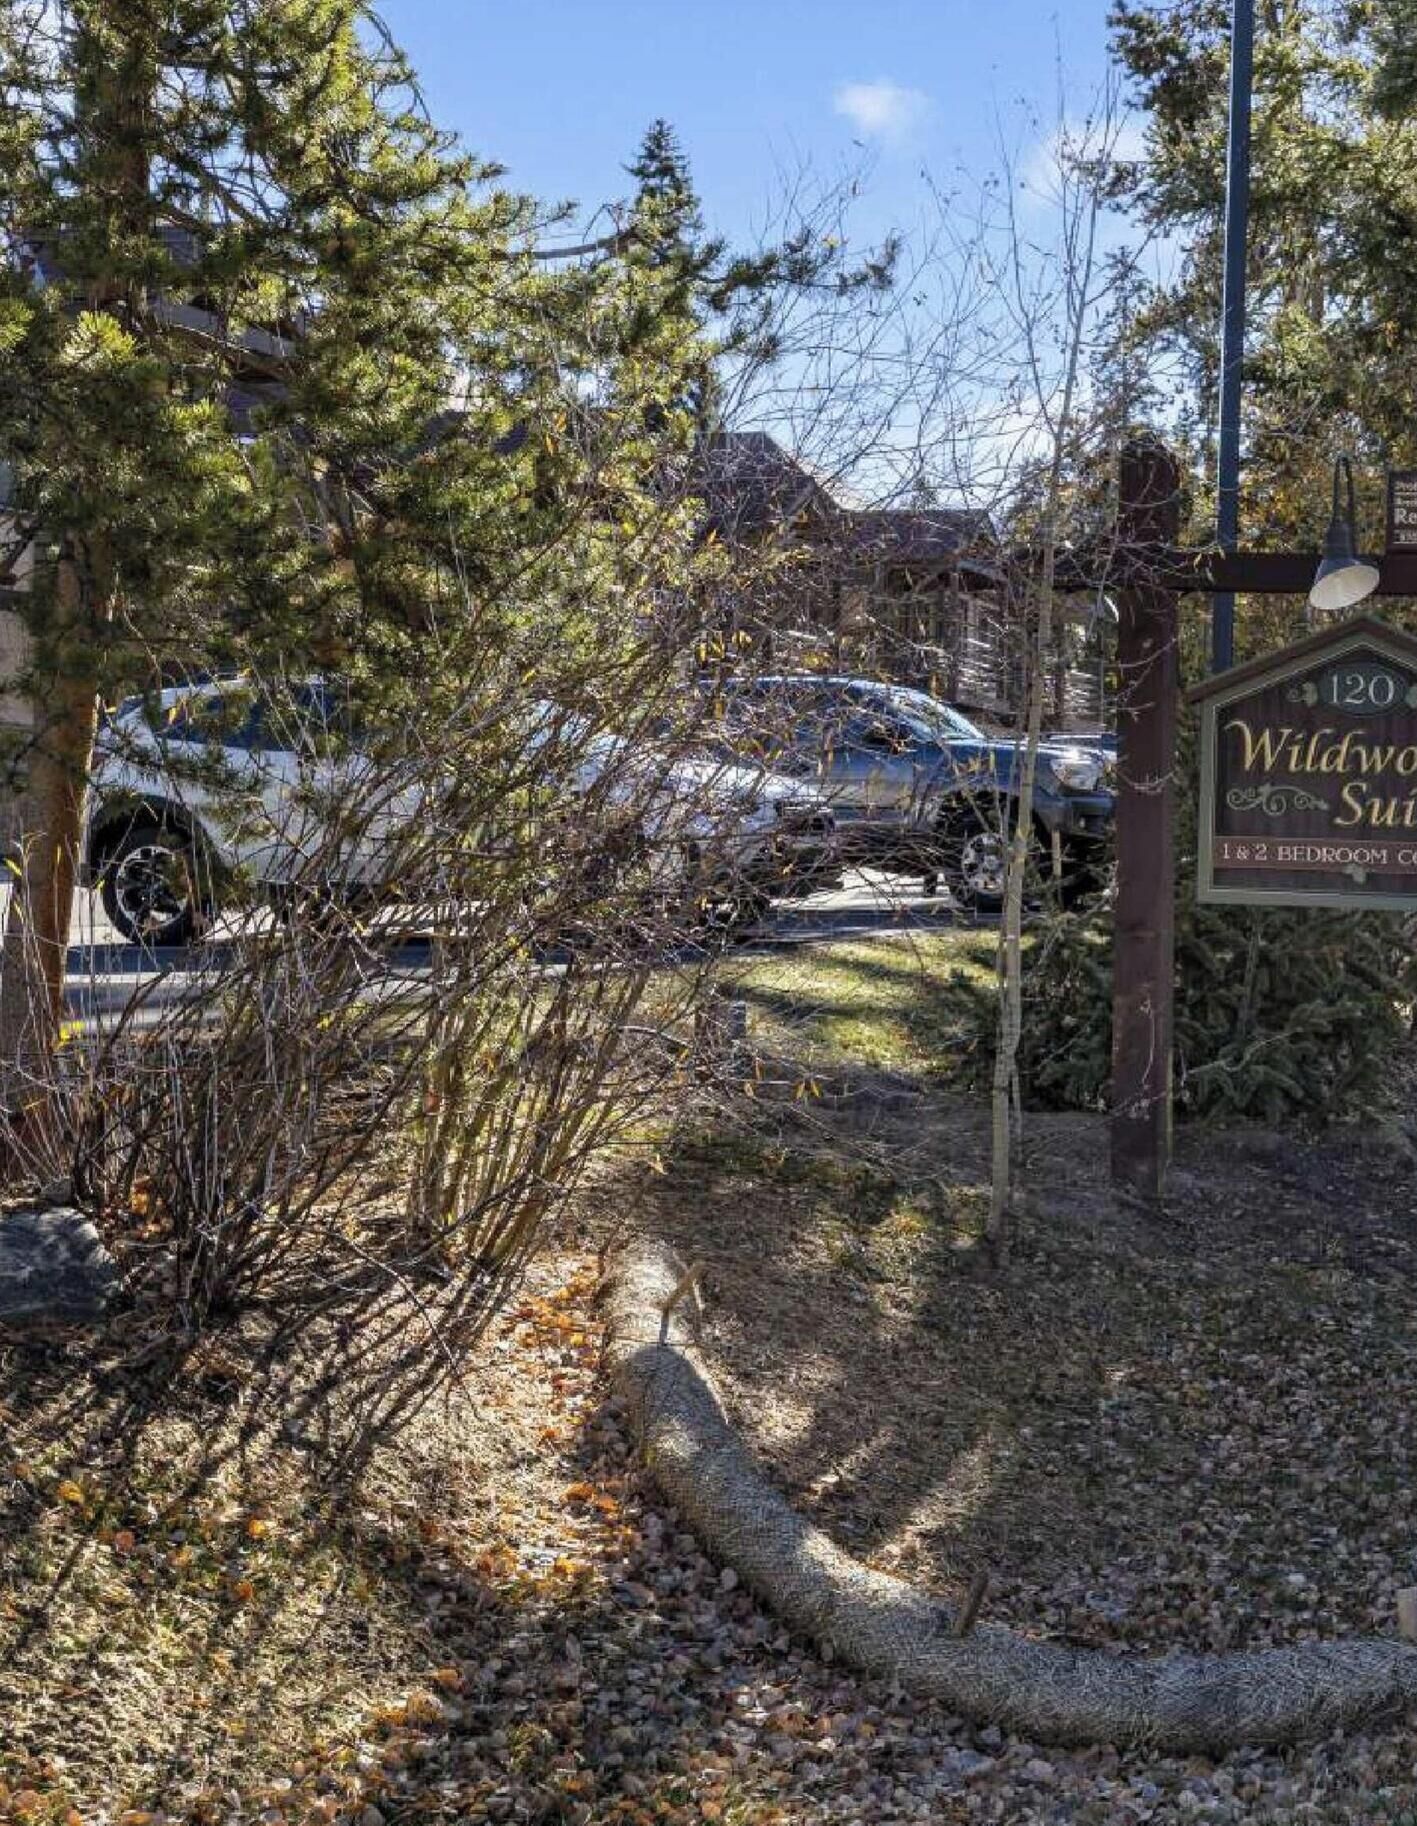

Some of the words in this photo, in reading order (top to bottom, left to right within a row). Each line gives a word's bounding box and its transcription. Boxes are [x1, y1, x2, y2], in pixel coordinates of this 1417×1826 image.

[1331, 674, 1395, 705] 120
[1223, 843, 1231, 860] 1
[1236, 846, 1249, 861] &
[1253, 843, 1268, 862] 2
[1277, 845, 1388, 866] BEDROOM
